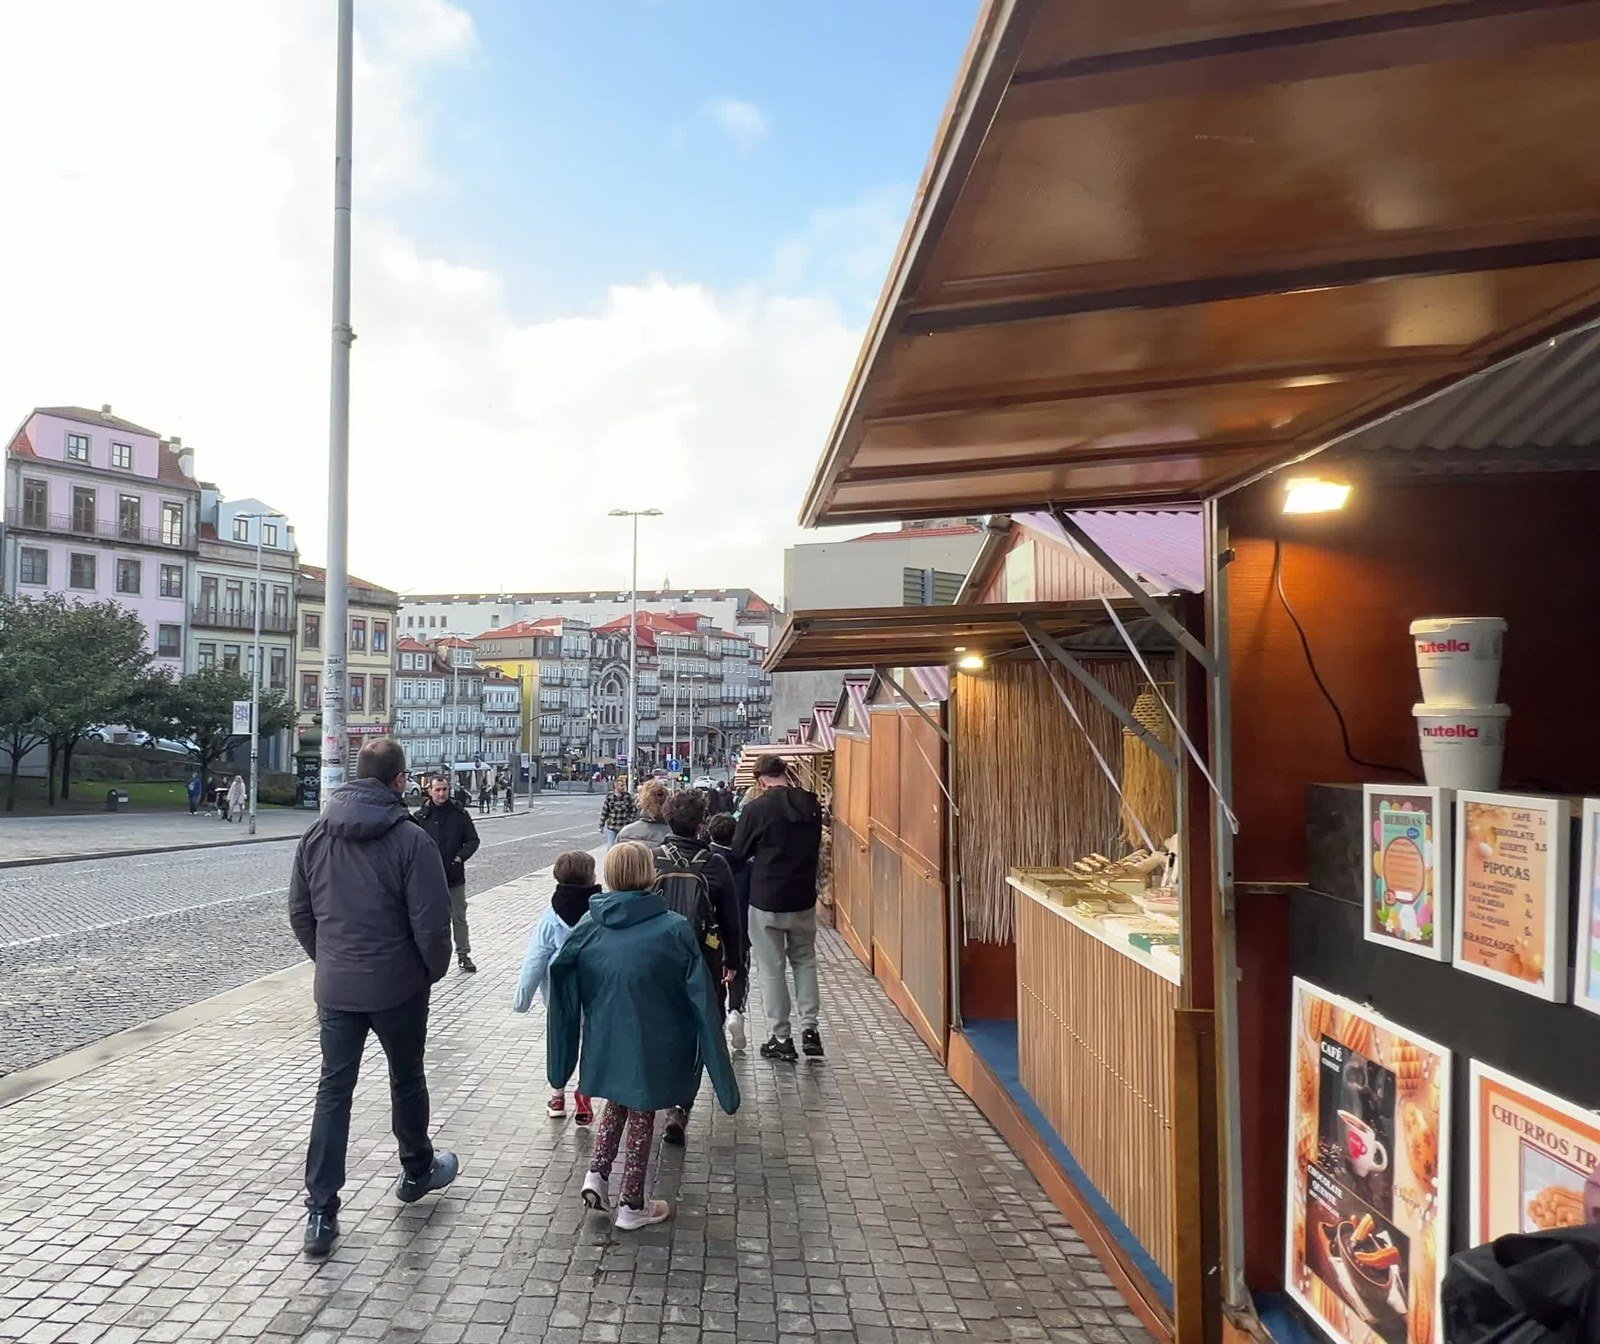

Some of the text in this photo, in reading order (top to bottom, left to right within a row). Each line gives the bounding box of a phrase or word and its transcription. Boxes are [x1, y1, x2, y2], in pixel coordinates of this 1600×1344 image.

[1418, 639, 1470, 653] nutella
[1423, 724, 1479, 738] nutella
[1482, 861, 1530, 882] PIPOCAS
[1321, 1041, 1343, 1062] CAFÉ
[1492, 1104, 1569, 1156] CHURROS
